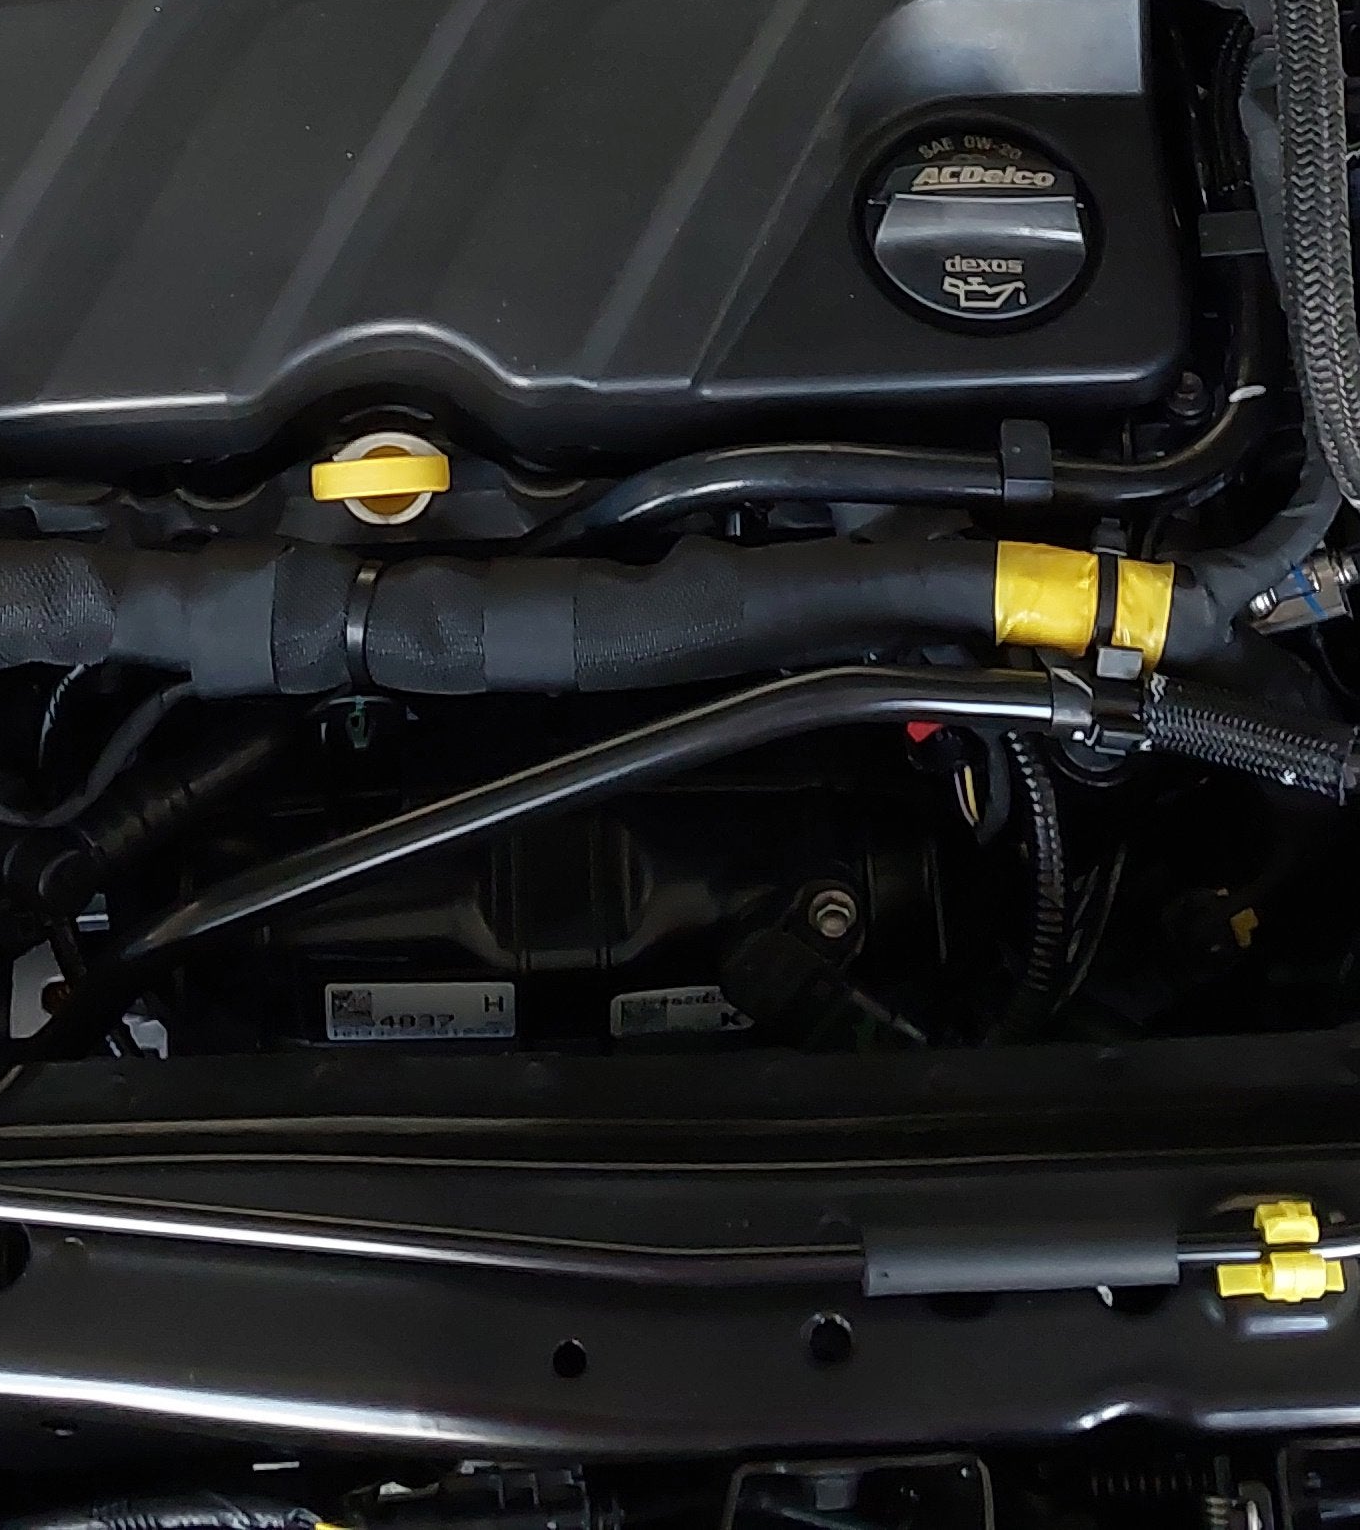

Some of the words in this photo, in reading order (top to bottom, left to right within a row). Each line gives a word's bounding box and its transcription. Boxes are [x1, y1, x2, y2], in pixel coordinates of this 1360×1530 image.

[918, 137, 955, 159] SAE
[911, 165, 1056, 188] ACDelco
[944, 254, 1025, 274] dexos
[483, 994, 504, 1013] H
